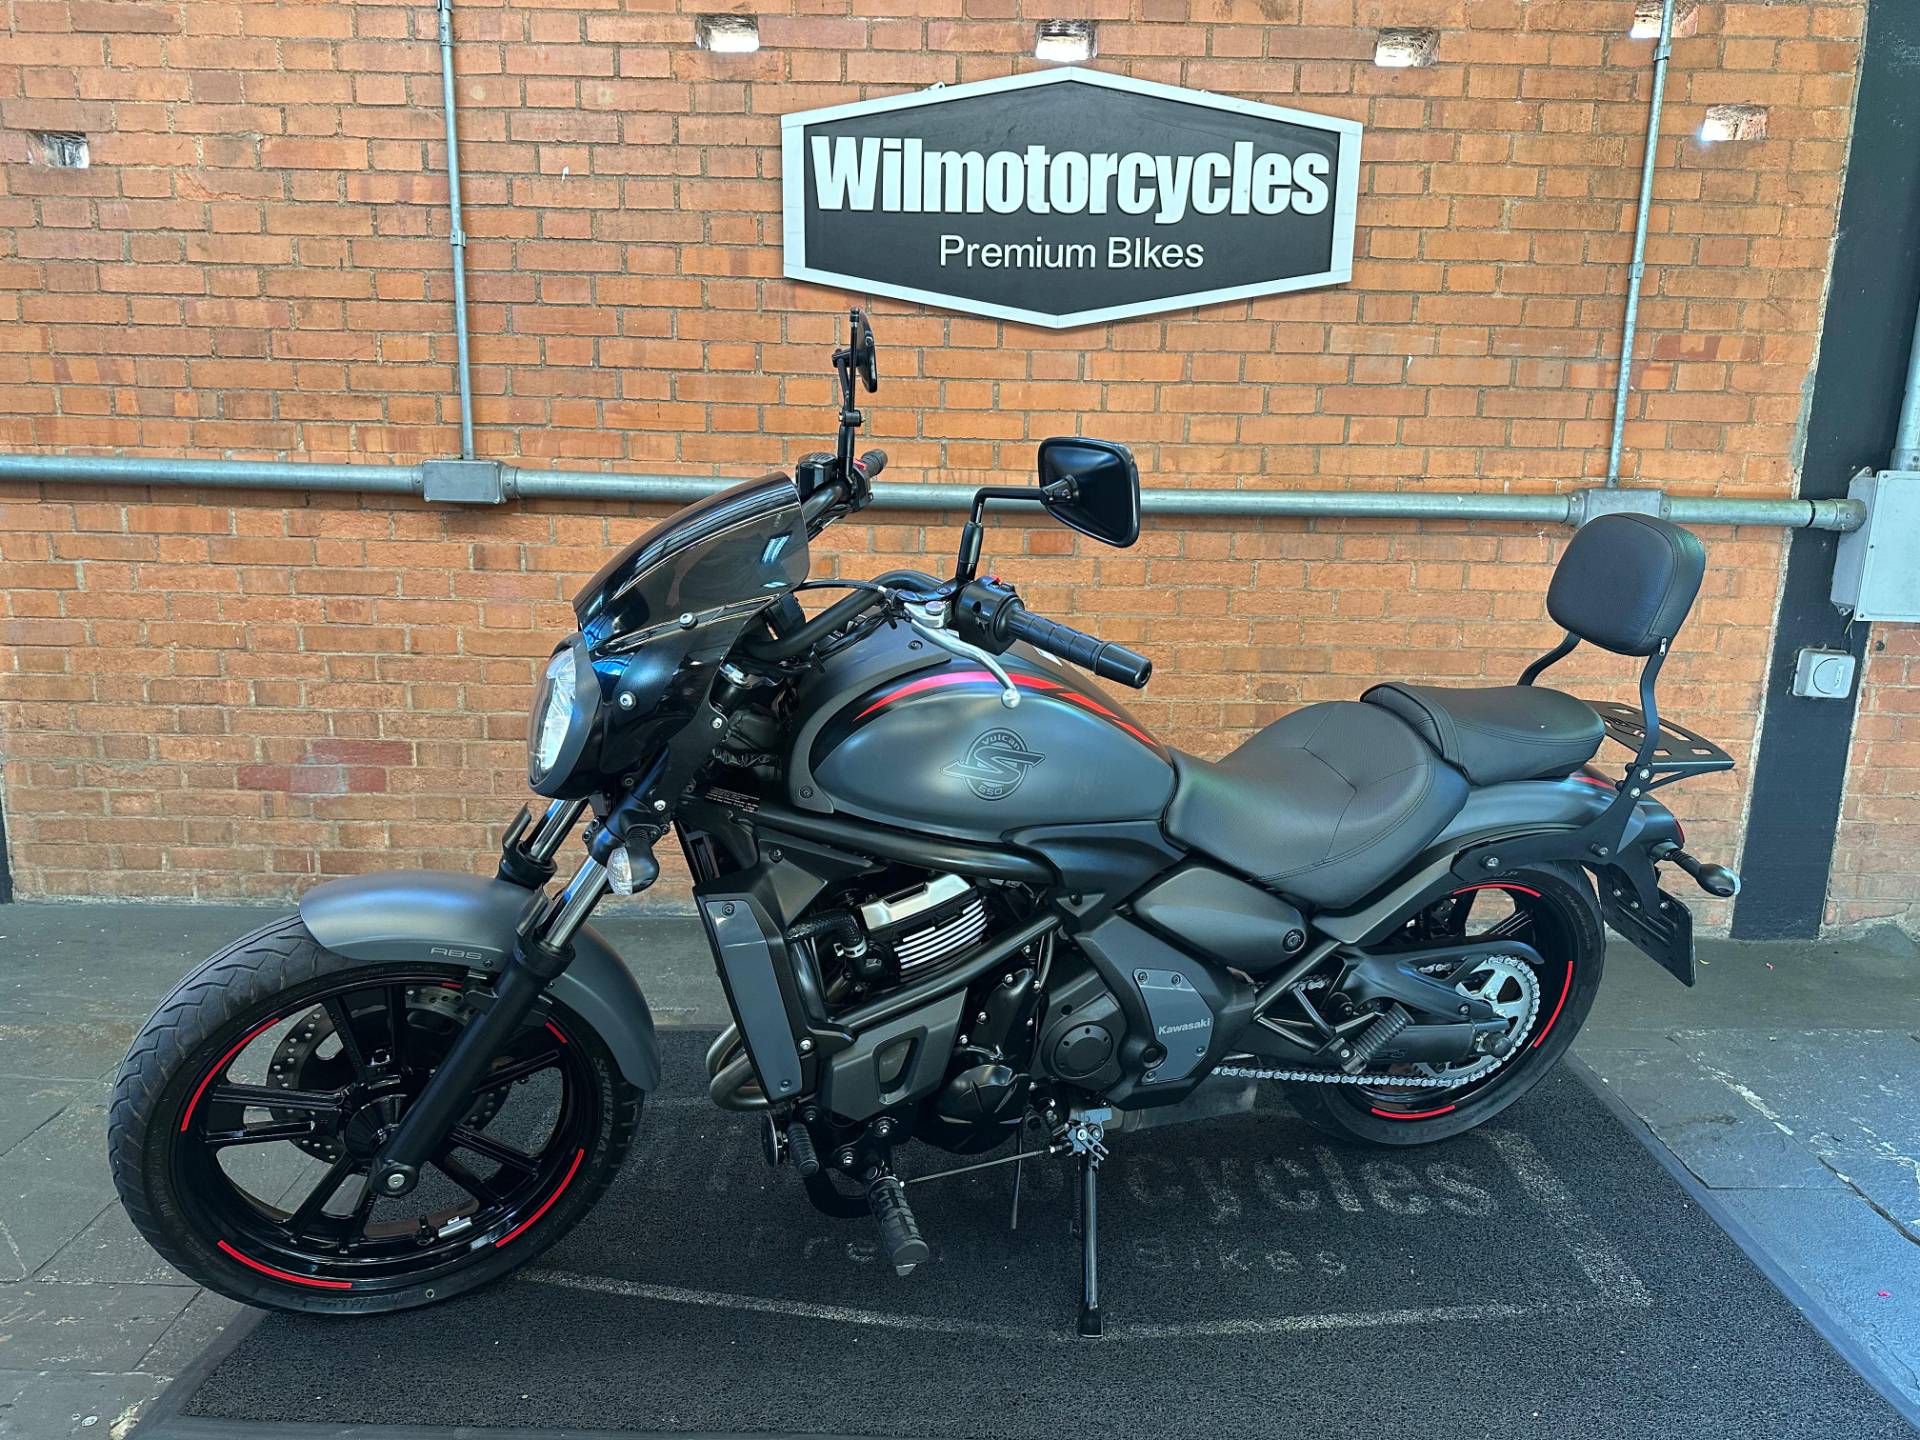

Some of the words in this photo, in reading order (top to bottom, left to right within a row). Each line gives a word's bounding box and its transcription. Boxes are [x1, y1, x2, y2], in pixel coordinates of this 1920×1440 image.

[811, 135, 1330, 224] Wilmotorcycles
[939, 234, 1096, 268] Premium
[978, 784, 1003, 796] 650
[430, 947, 482, 960] ABS
[1158, 1017, 1211, 1036] Kawasaki
